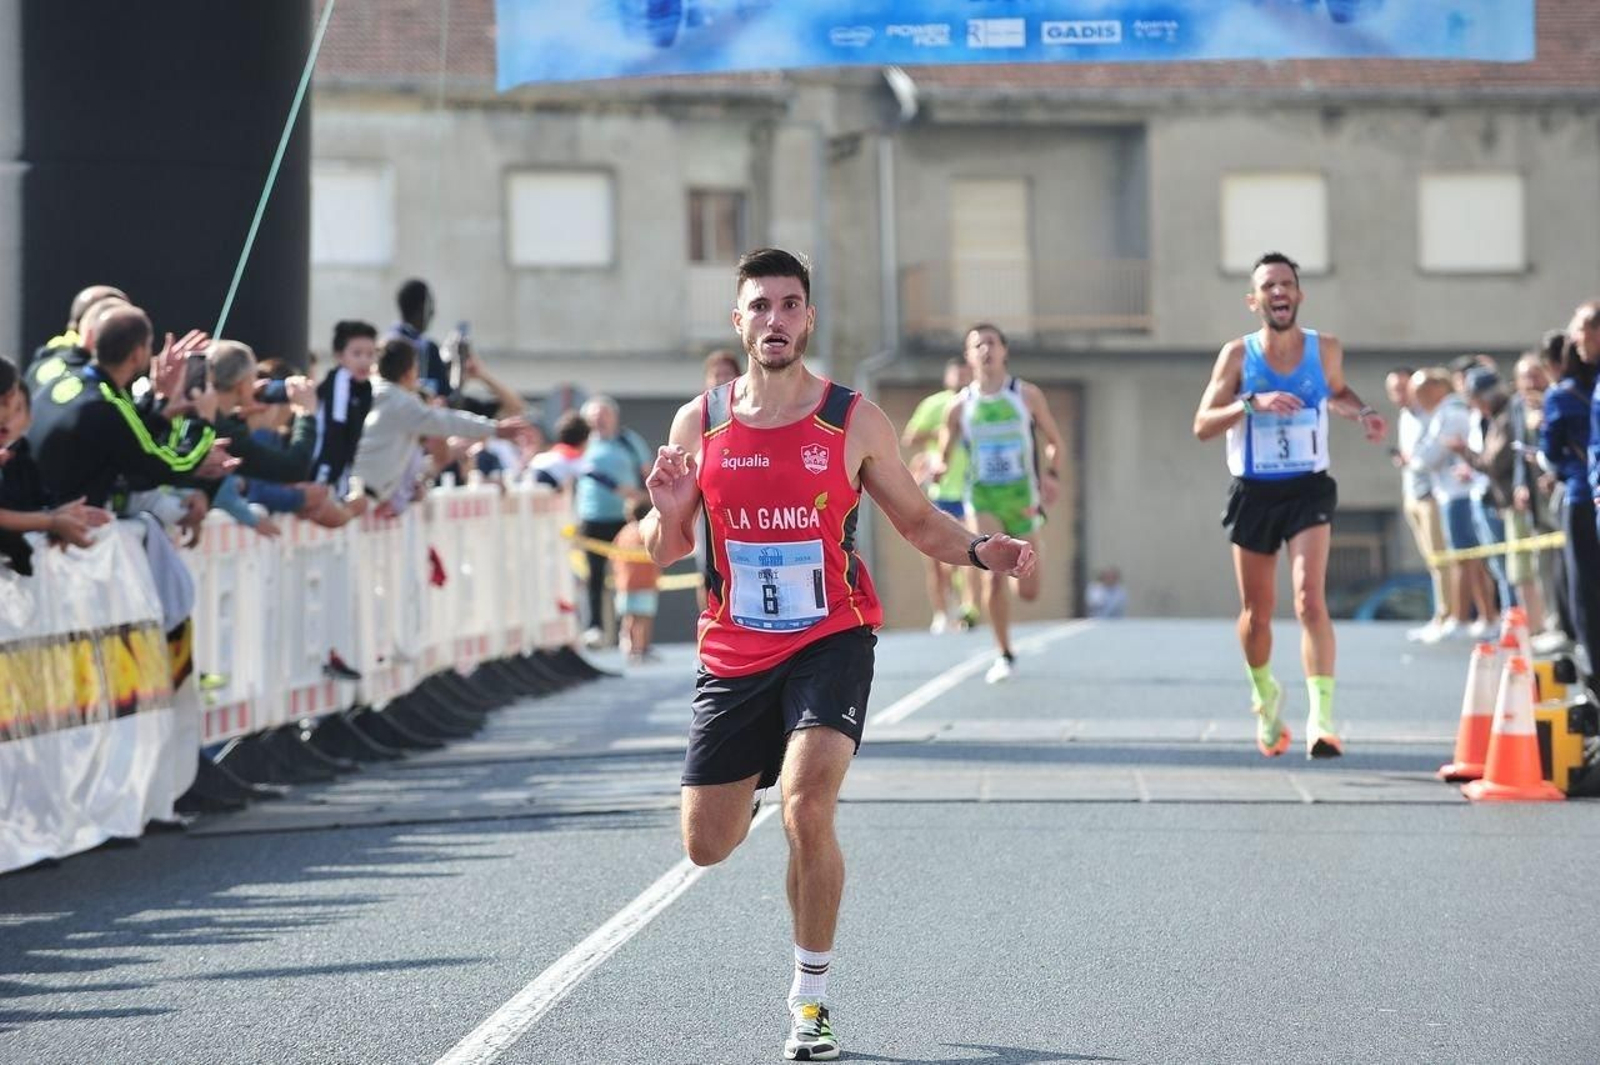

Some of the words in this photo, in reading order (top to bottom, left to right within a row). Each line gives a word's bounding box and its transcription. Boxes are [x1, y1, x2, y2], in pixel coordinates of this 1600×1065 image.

[1046, 25, 1115, 40] GADIS
[1278, 438, 1290, 460] 3
[721, 453, 770, 470] aqualia
[726, 507, 751, 530] LA
[757, 506, 821, 530] GANGA
[762, 584, 779, 615] 6
